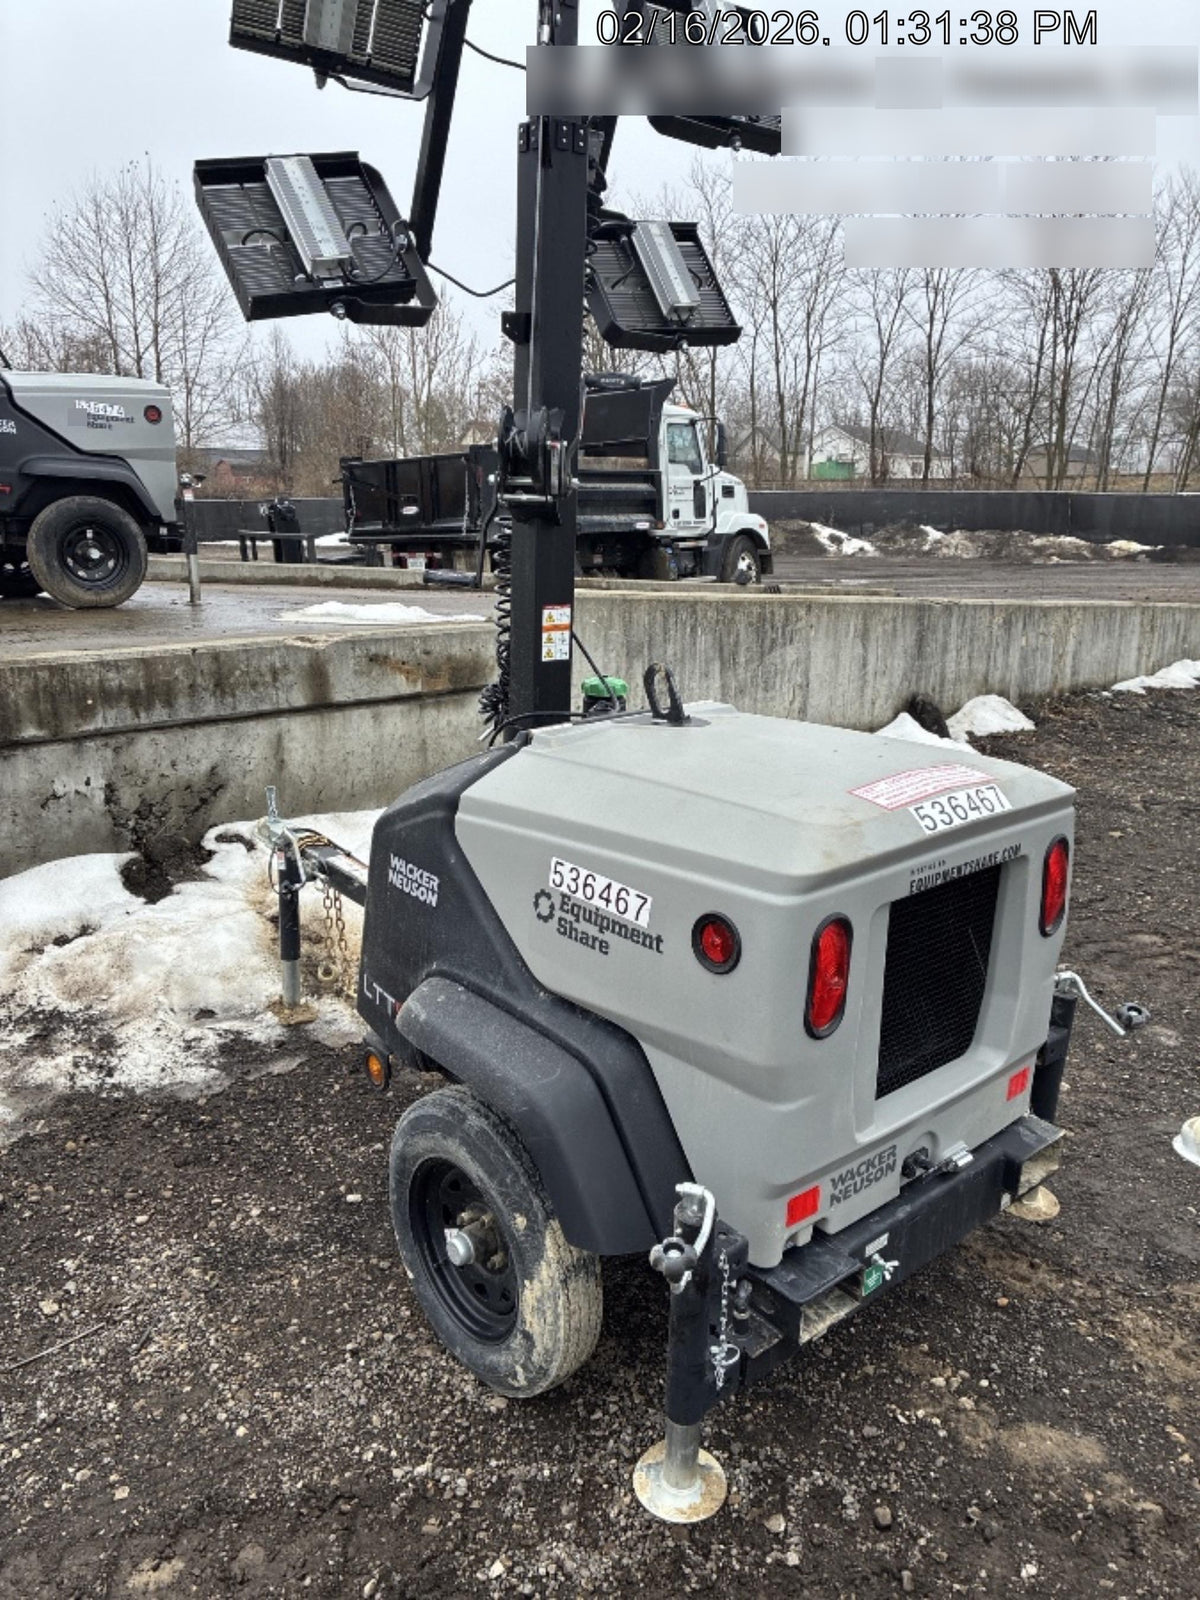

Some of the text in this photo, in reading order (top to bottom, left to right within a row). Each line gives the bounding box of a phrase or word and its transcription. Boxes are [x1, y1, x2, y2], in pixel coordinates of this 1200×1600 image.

[913, 785, 1006, 832] 536467
[388, 868, 438, 908] NEUSON
[390, 852, 439, 892] WACKER
[552, 860, 649, 922] 536467
[910, 842, 1022, 896] EQUIPMENTSHARE.COM
[556, 916, 609, 956] Share
[559, 891, 664, 955] Equipment
[829, 1158, 897, 1208] NEUSON
[830, 1144, 897, 1191] WACKER
